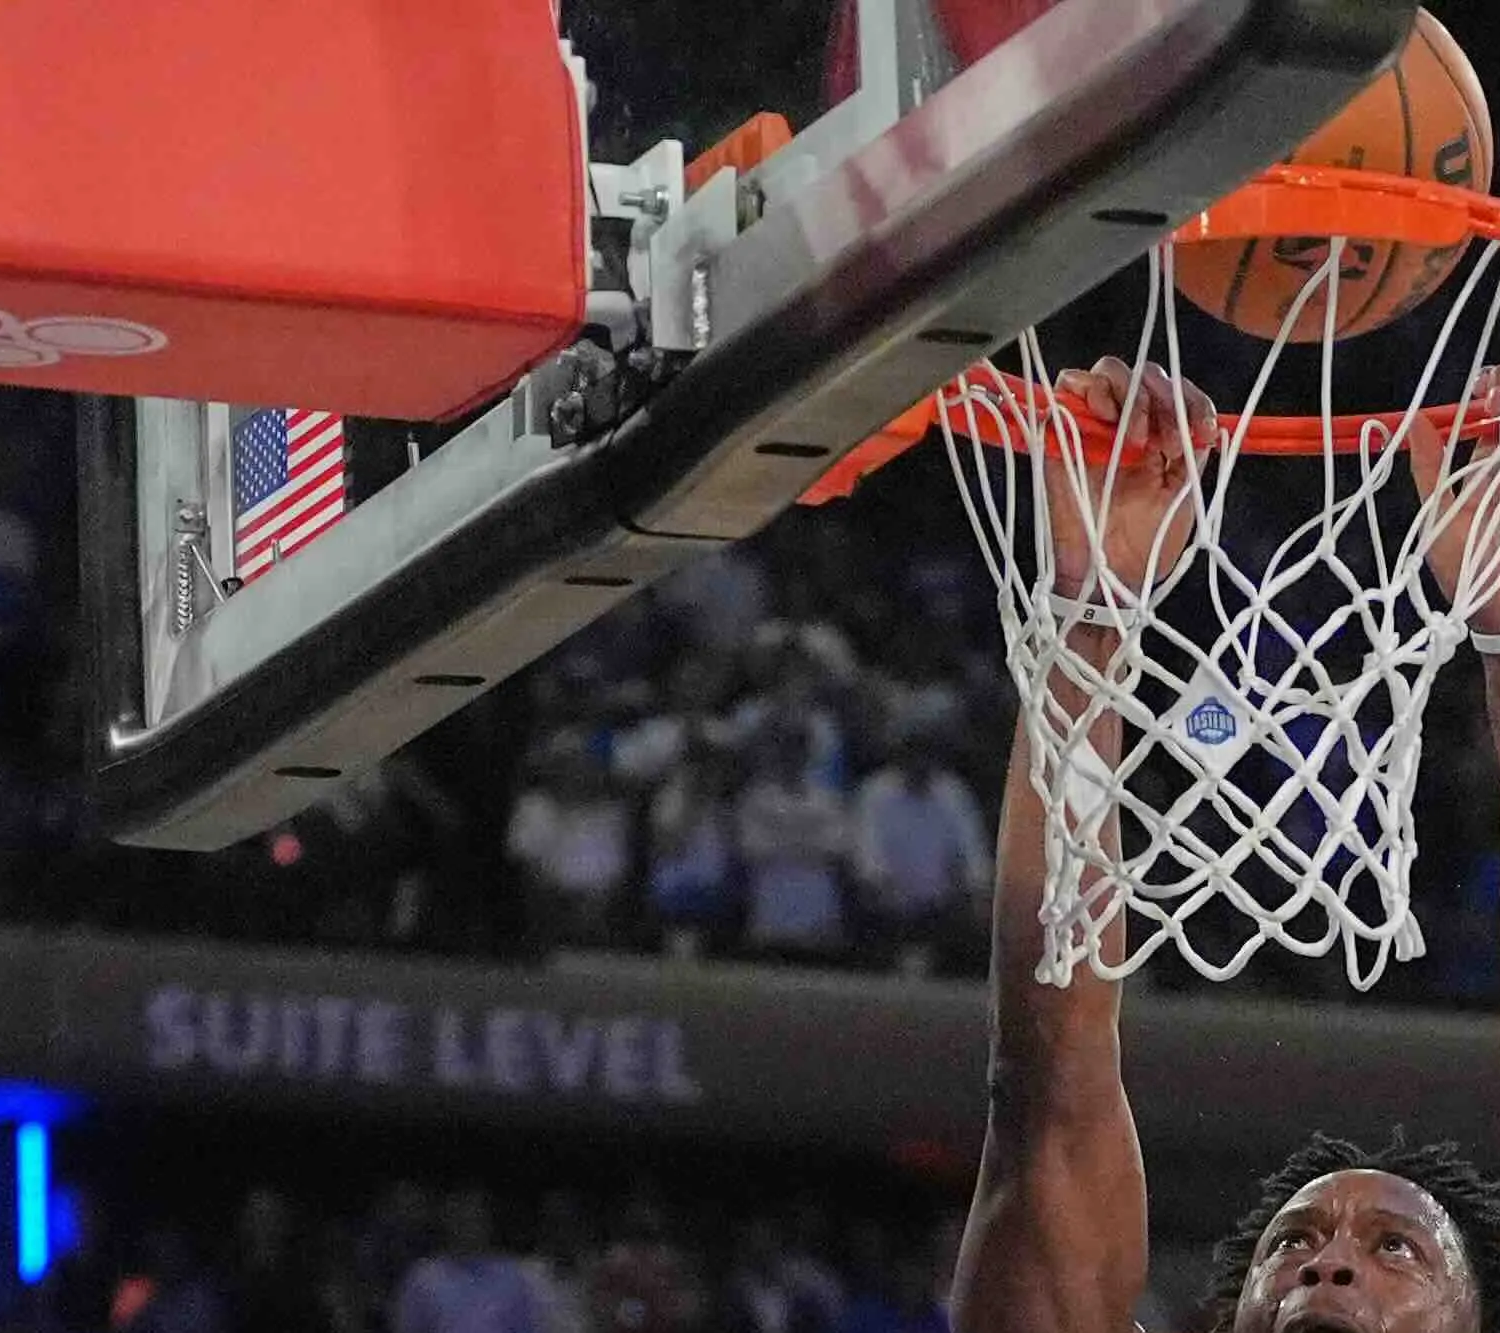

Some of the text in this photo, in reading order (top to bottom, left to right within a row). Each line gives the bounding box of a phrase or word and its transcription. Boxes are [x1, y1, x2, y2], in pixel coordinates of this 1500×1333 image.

[1083, 607, 1096, 620] 8
[146, 984, 700, 1103] SUITE LEVEL
